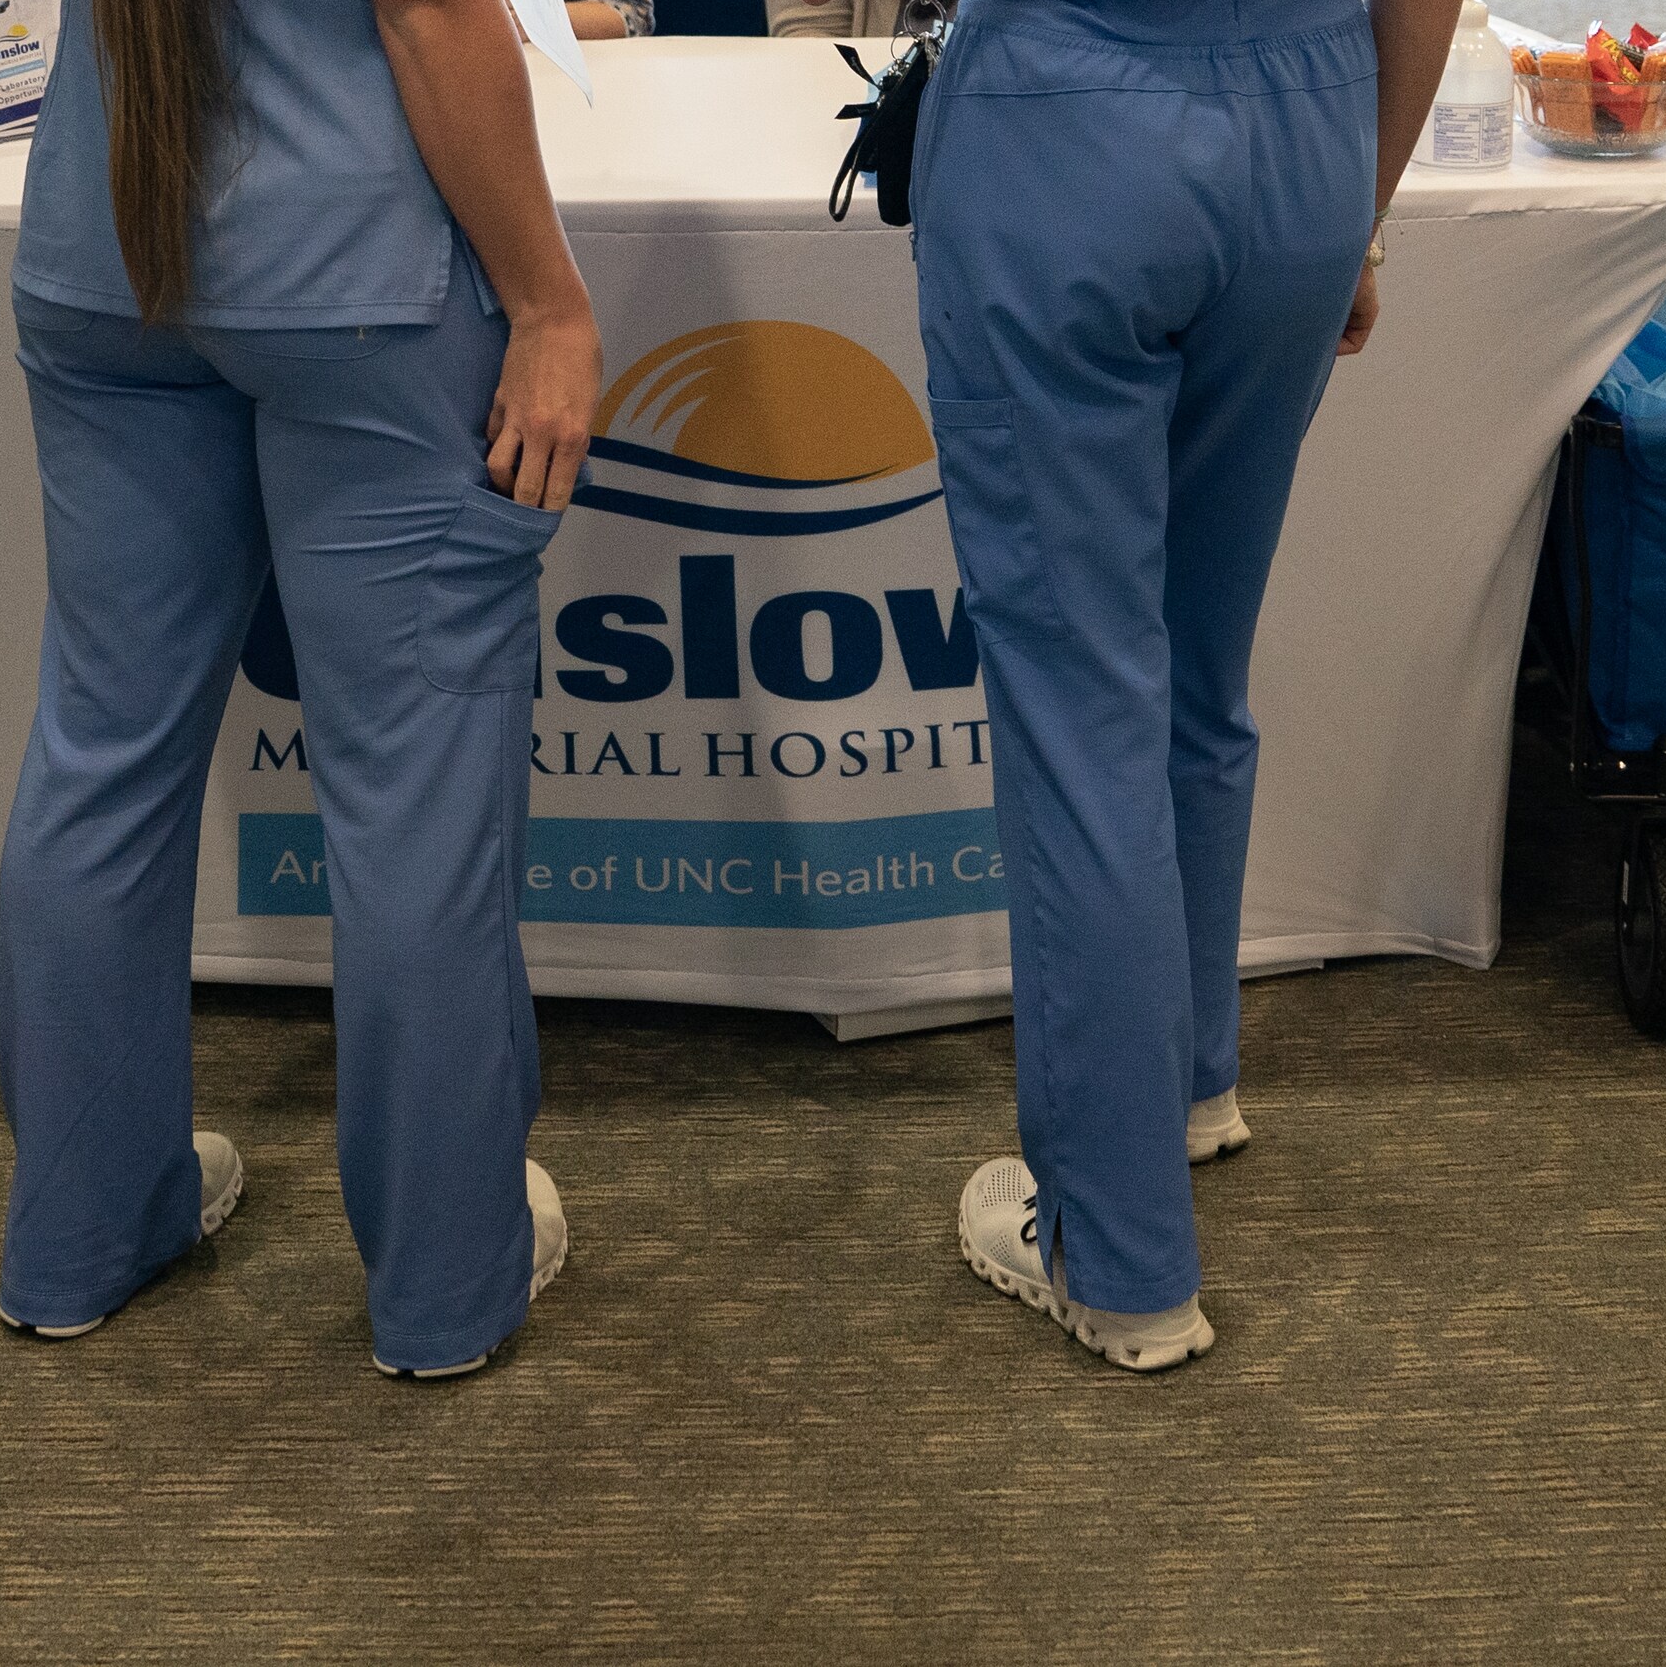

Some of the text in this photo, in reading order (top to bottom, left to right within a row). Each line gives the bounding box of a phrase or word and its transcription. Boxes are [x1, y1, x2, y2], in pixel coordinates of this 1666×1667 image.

[0, 75, 46, 93] Laboratory
[240, 553, 981, 703] slo
[249, 720, 989, 780] MRIAL HOSPIT
[570, 856, 618, 892] of
[635, 857, 754, 896] UNC
[773, 850, 934, 897] Health
[952, 845, 1005, 884] Ca
